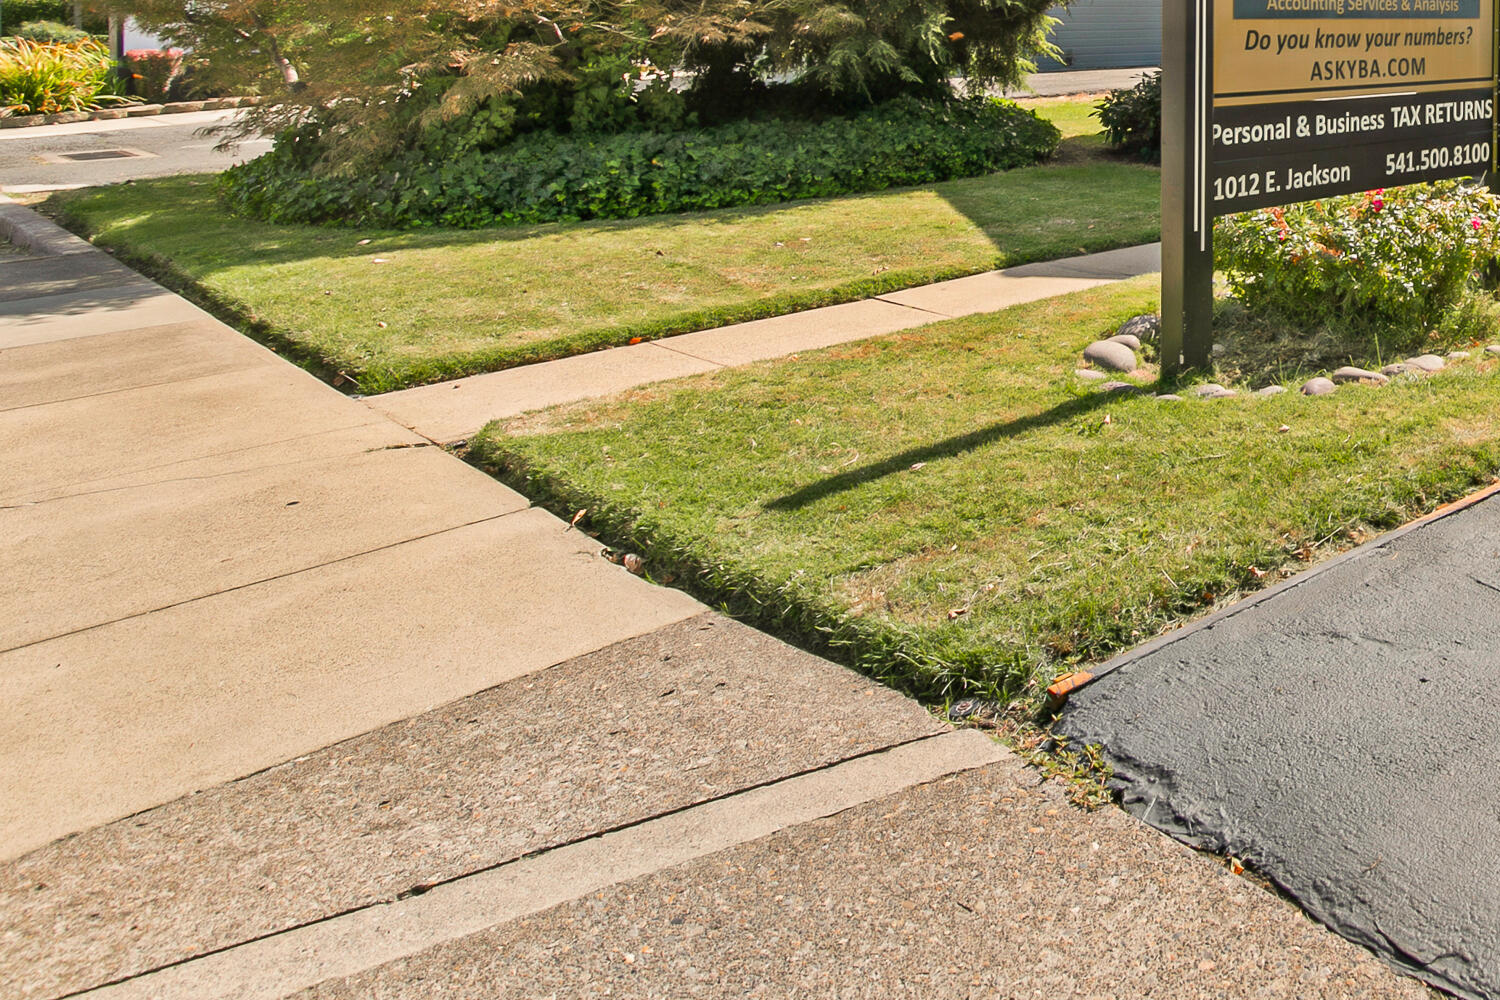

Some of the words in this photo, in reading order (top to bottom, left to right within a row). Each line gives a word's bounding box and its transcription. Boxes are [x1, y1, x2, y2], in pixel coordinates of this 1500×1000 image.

[1244, 29, 1271, 51] Do
[1276, 33, 1310, 55] you
[1314, 27, 1361, 49] know
[1365, 32, 1401, 52] your
[1404, 26, 1473, 47] numbers?
[1310, 57, 1426, 81] ASKYBA.COM
[1212, 115, 1291, 146] Personal
[1295, 115, 1311, 137] &
[1315, 111, 1385, 136] Business
[1390, 105, 1422, 128] TAX
[1425, 99, 1493, 125] RETURNS
[1213, 172, 1260, 201] 1012
[1265, 170, 1281, 193] E.
[1285, 163, 1351, 190] Jackson
[1385, 142, 1490, 175] 541.500.8100
